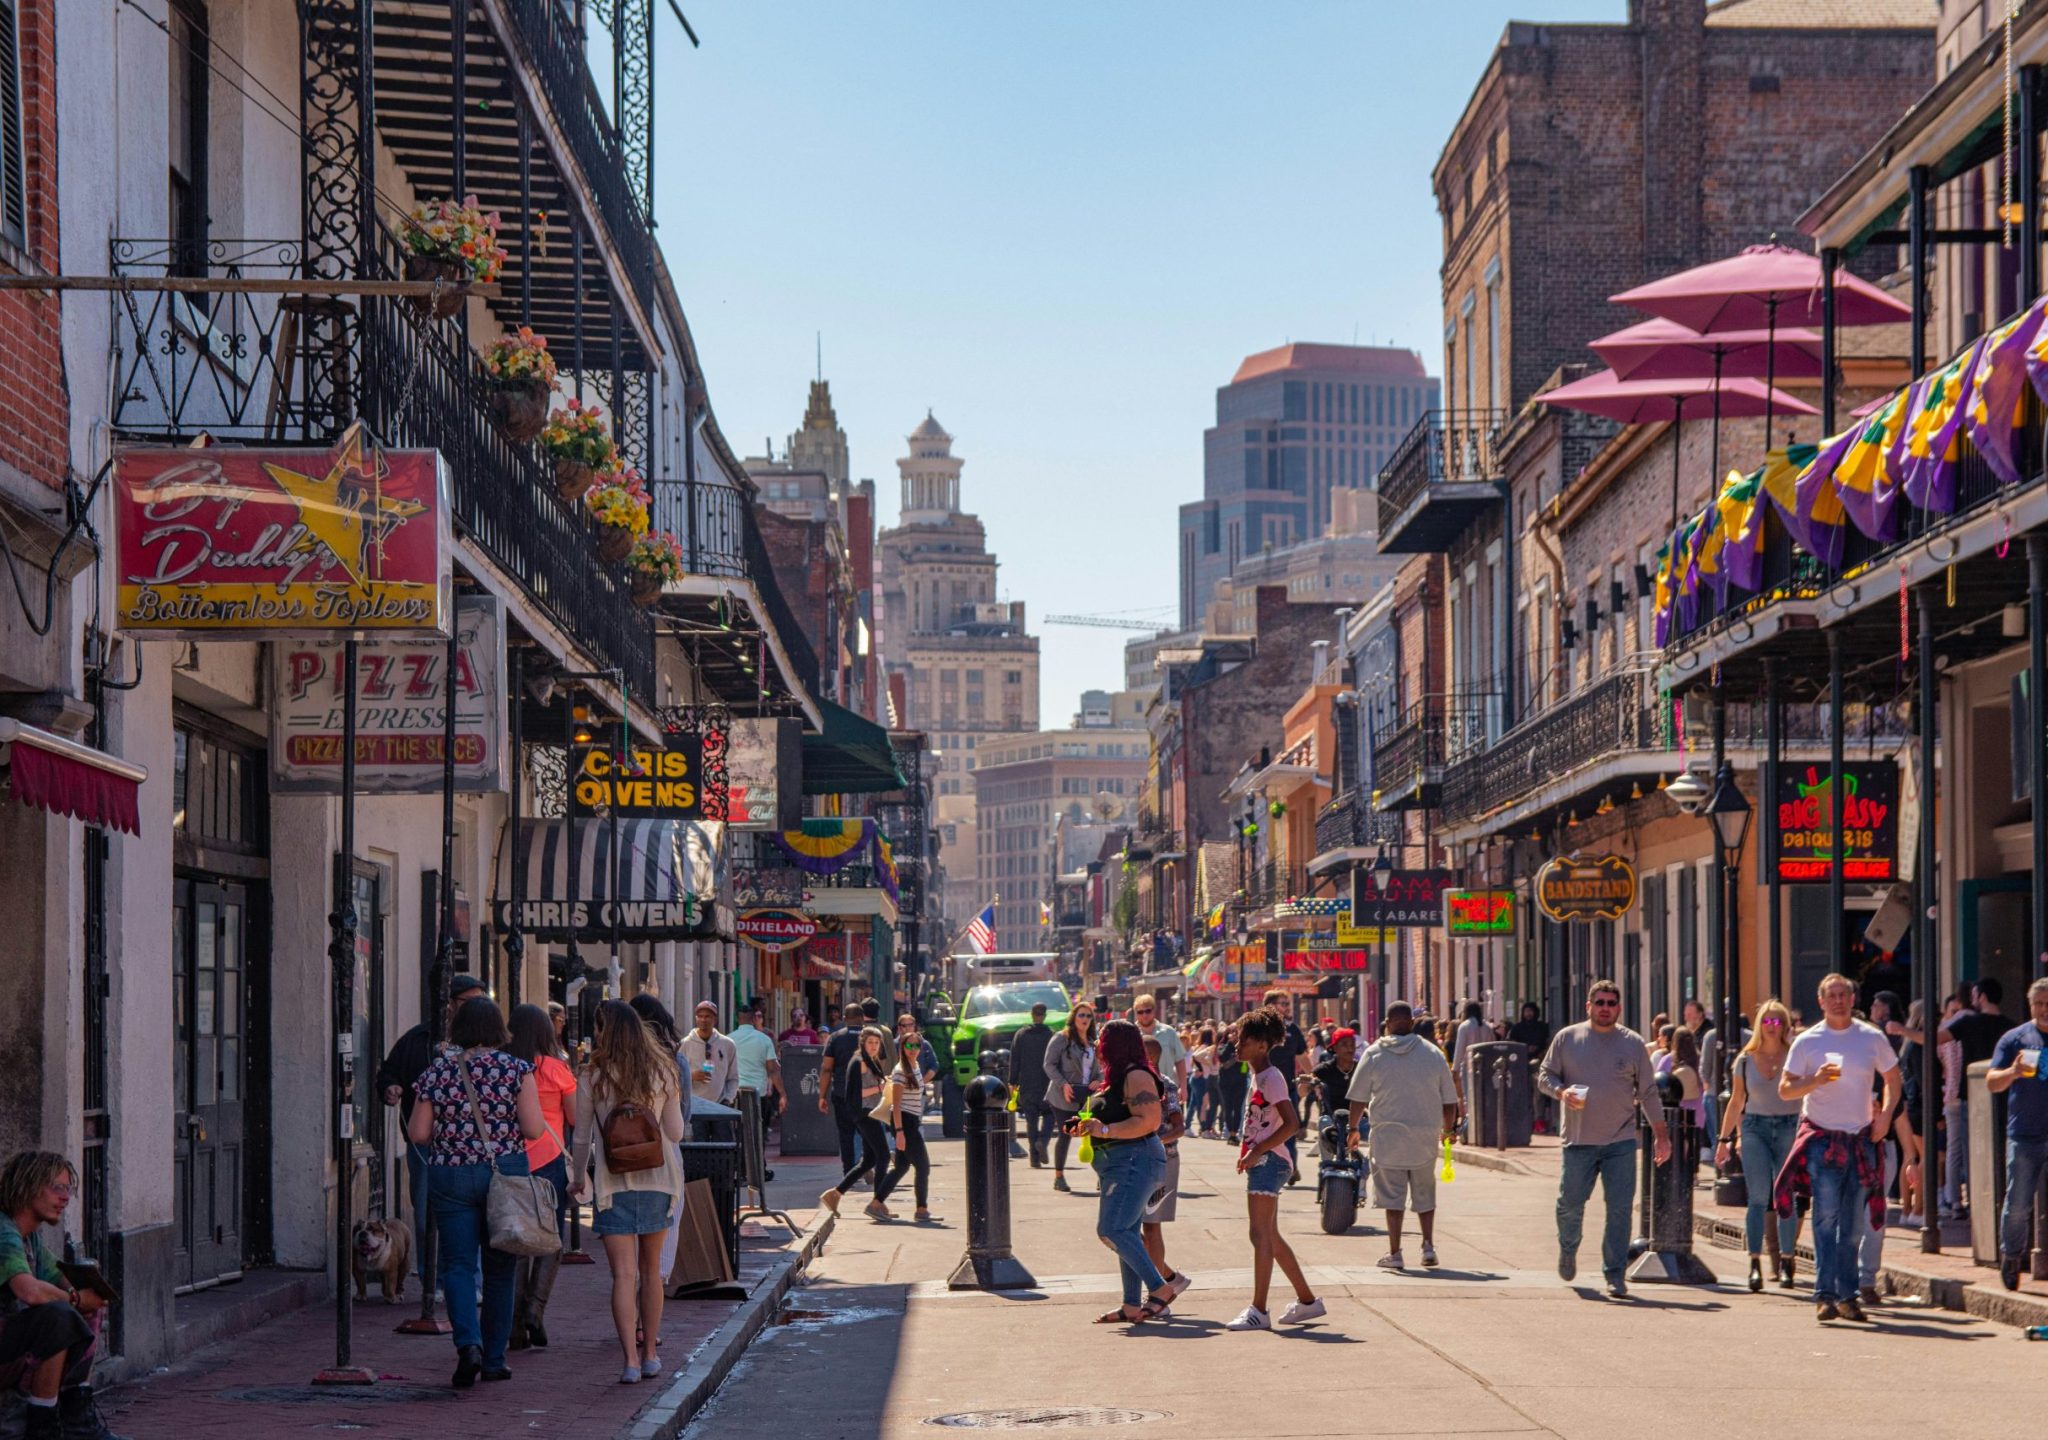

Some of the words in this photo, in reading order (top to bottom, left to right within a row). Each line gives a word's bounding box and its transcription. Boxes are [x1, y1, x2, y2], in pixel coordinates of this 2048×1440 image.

[127, 523, 338, 594] Daddy's
[129, 588, 306, 622] Bottomless
[313, 589, 430, 625] Topless
[355, 737, 379, 762] BY
[384, 737, 420, 762] THE
[426, 737, 479, 763] SLCE
[575, 781, 696, 808] OWENS
[1779, 795, 1821, 829] BIG
[1364, 889, 1444, 902] SUTR
[1546, 880, 1630, 898] BANDSTAND
[601, 902, 703, 928] OWENS
[736, 920, 816, 934] DIXIELAND
